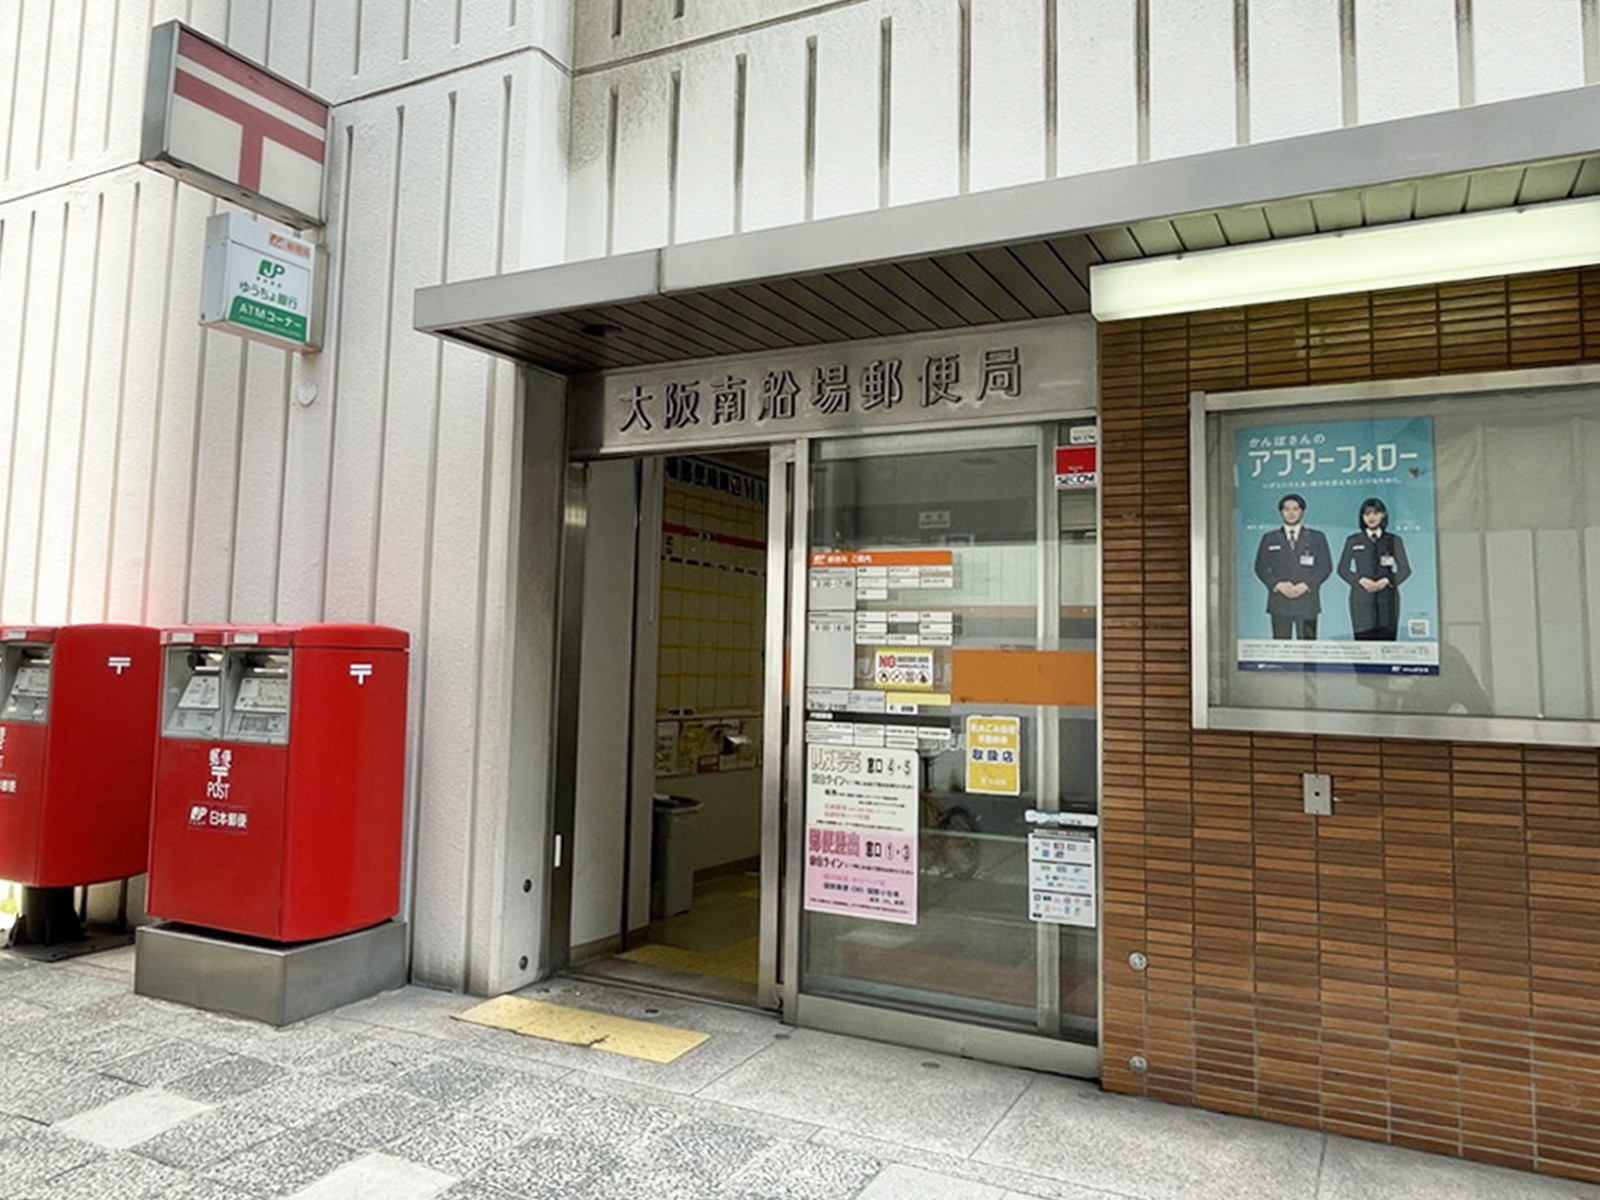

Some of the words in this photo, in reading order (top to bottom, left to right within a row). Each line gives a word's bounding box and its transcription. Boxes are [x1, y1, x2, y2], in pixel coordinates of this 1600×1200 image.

[239, 281, 298, 310] ゆうちょ銀行
[238, 302, 302, 329] ATMコーナー
[618, 347, 1022, 432] 大阪南船場郵便局
[1248, 443, 1418, 477] アフターフォロー
[878, 655, 896, 668] NO
[209, 748, 232, 768] 郵便
[810, 748, 861, 774] 販売
[972, 748, 1014, 763] 取扱店
[207, 781, 230, 800] POST
[209, 810, 248, 829] 日本郵便
